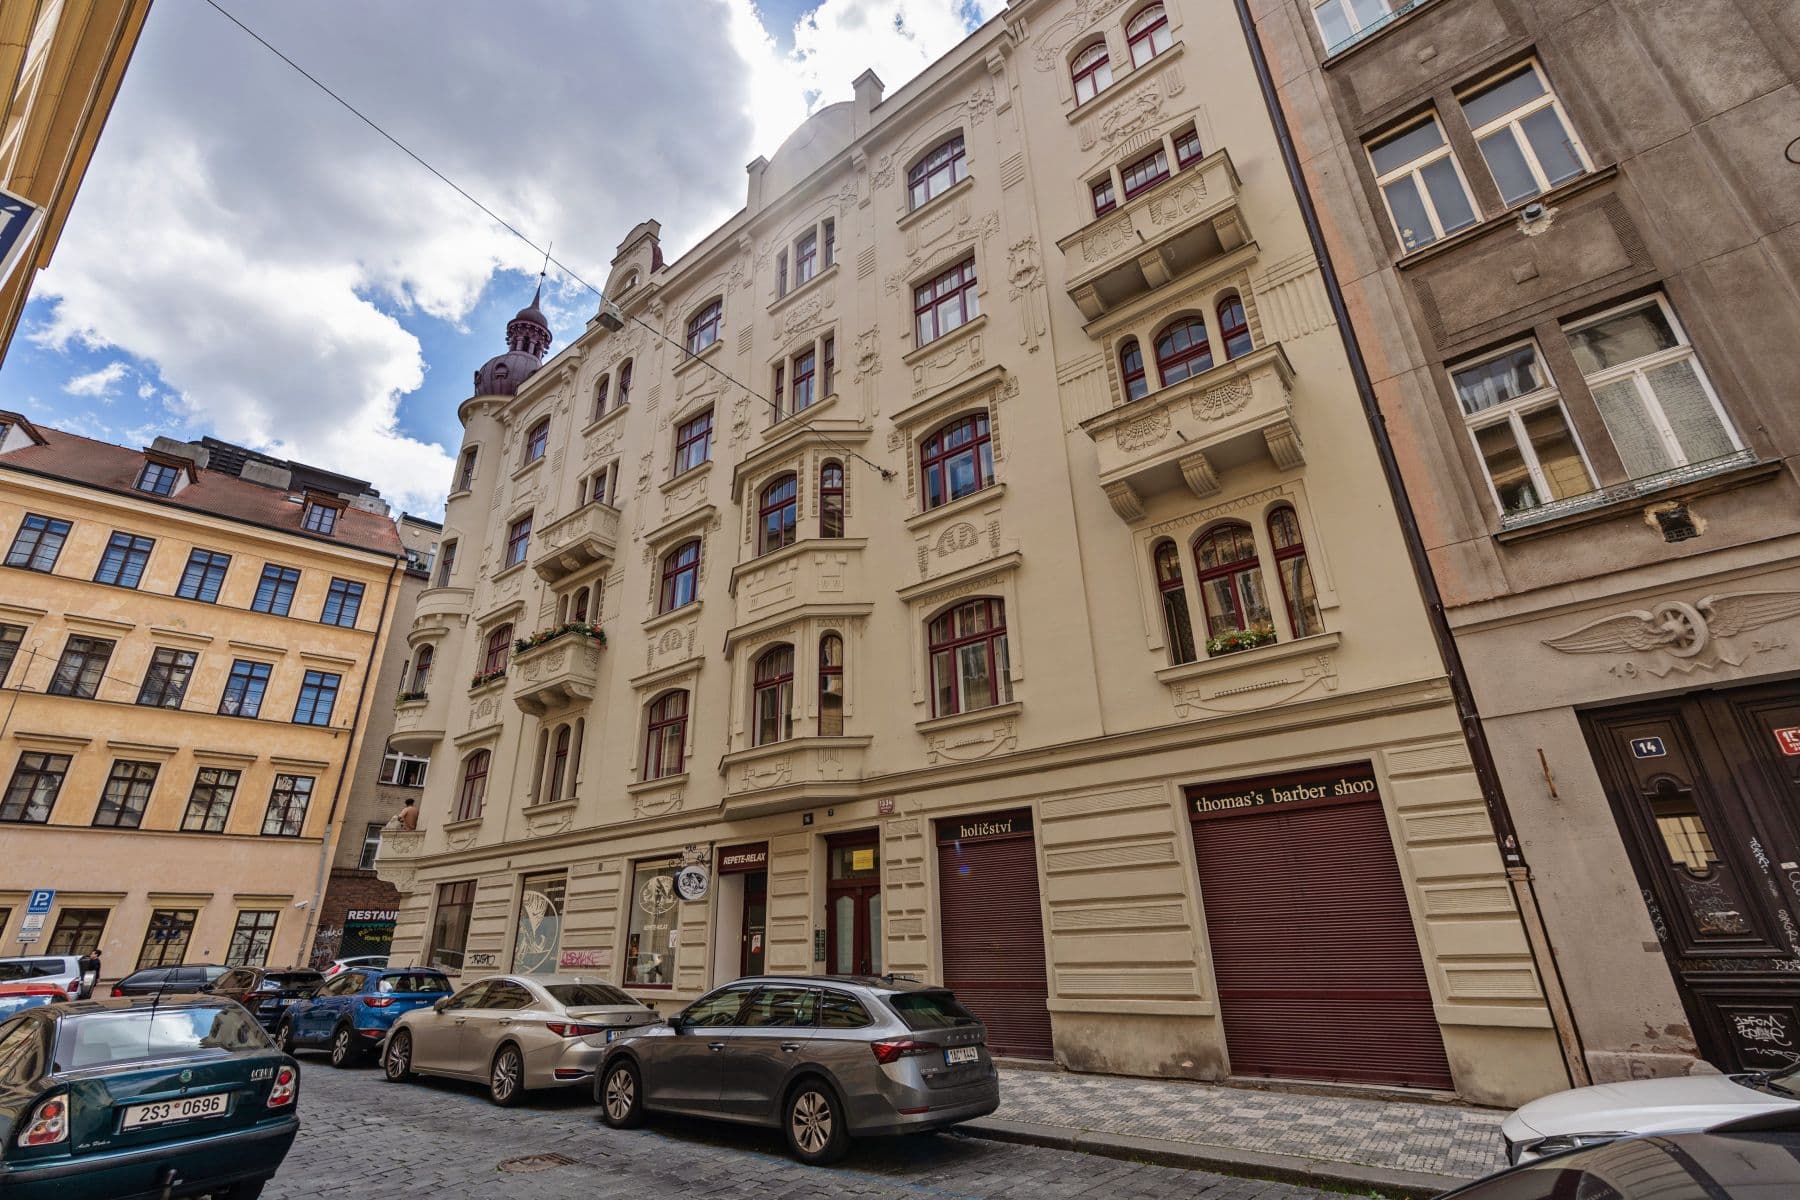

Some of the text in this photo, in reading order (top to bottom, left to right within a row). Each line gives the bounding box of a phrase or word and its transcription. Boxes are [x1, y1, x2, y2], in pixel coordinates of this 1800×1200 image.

[1639, 741, 1657, 754] 14
[1196, 778, 1375, 813] thomas's barber shop
[960, 819, 1012, 838] holičství
[723, 852, 766, 866] REPETE-RELAX
[34, 892, 50, 906] P
[139, 1096, 220, 1122] 2S3 0696
